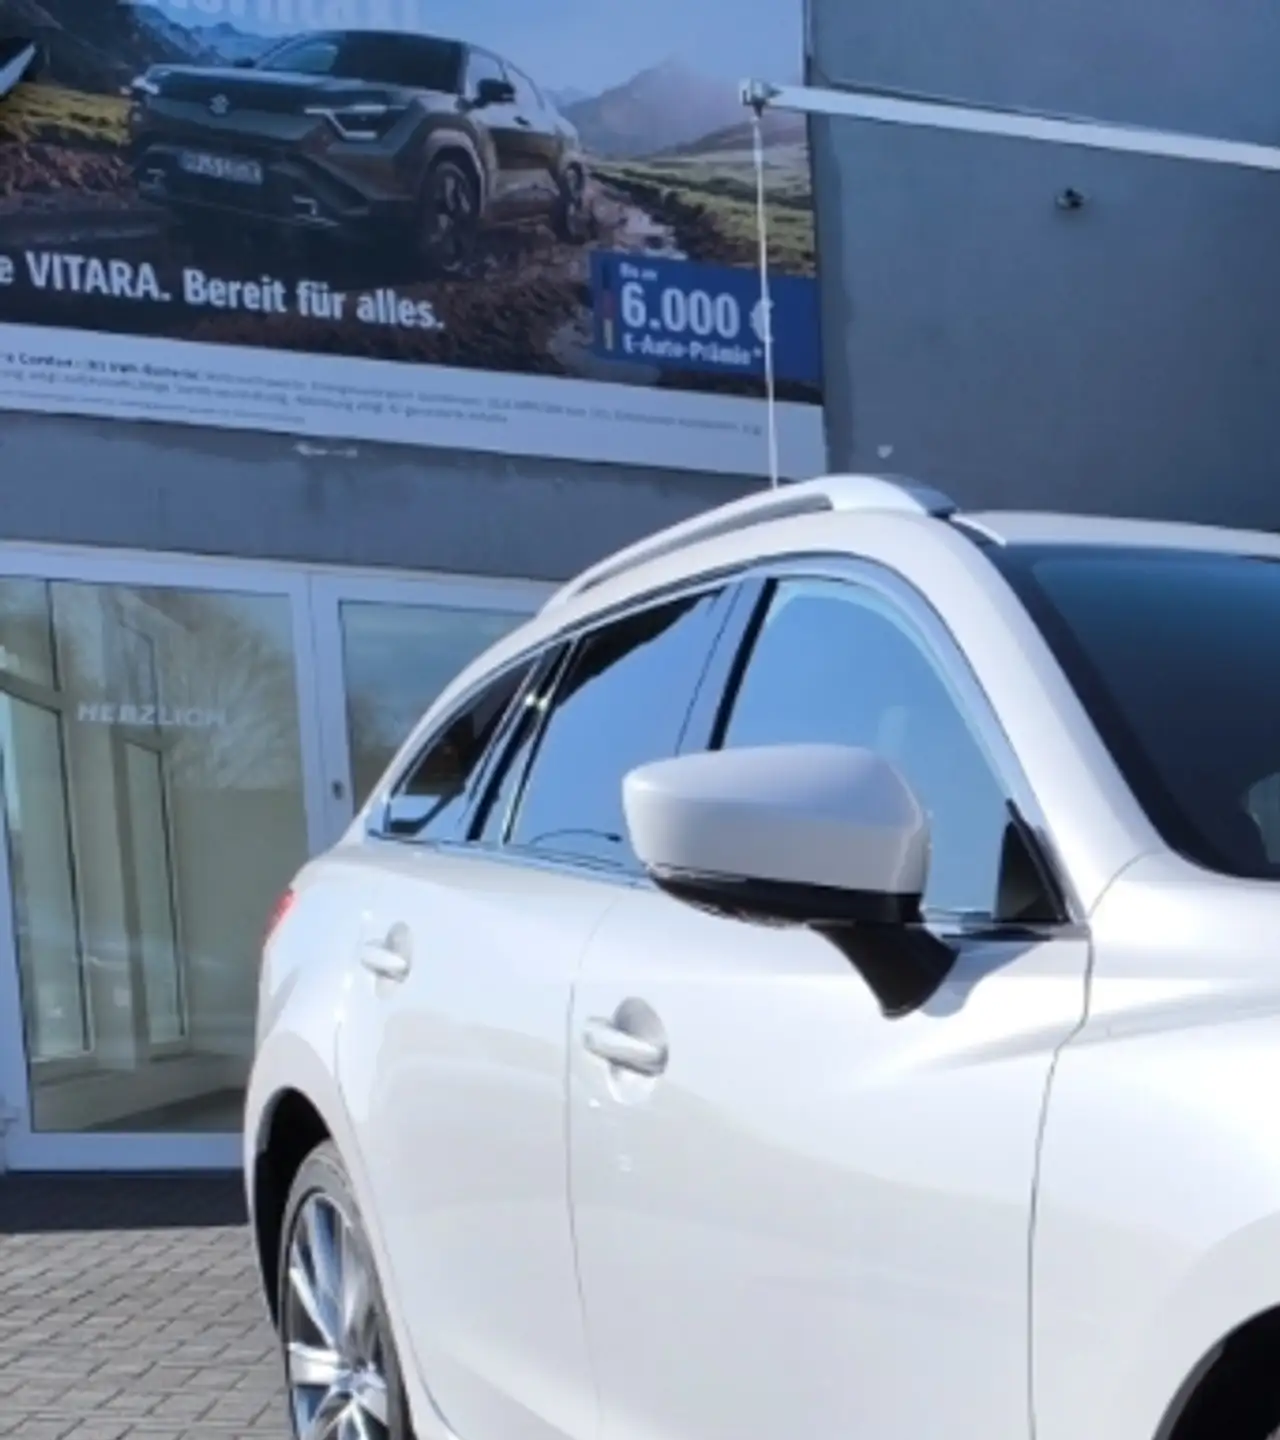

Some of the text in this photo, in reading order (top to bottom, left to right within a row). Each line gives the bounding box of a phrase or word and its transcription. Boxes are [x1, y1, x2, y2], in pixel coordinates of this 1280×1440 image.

[24, 251, 171, 301] VITARA.
[183, 268, 288, 313] Bereit
[299, 280, 346, 321] für
[356, 289, 446, 330] alles.
[621, 281, 740, 339] 6.000
